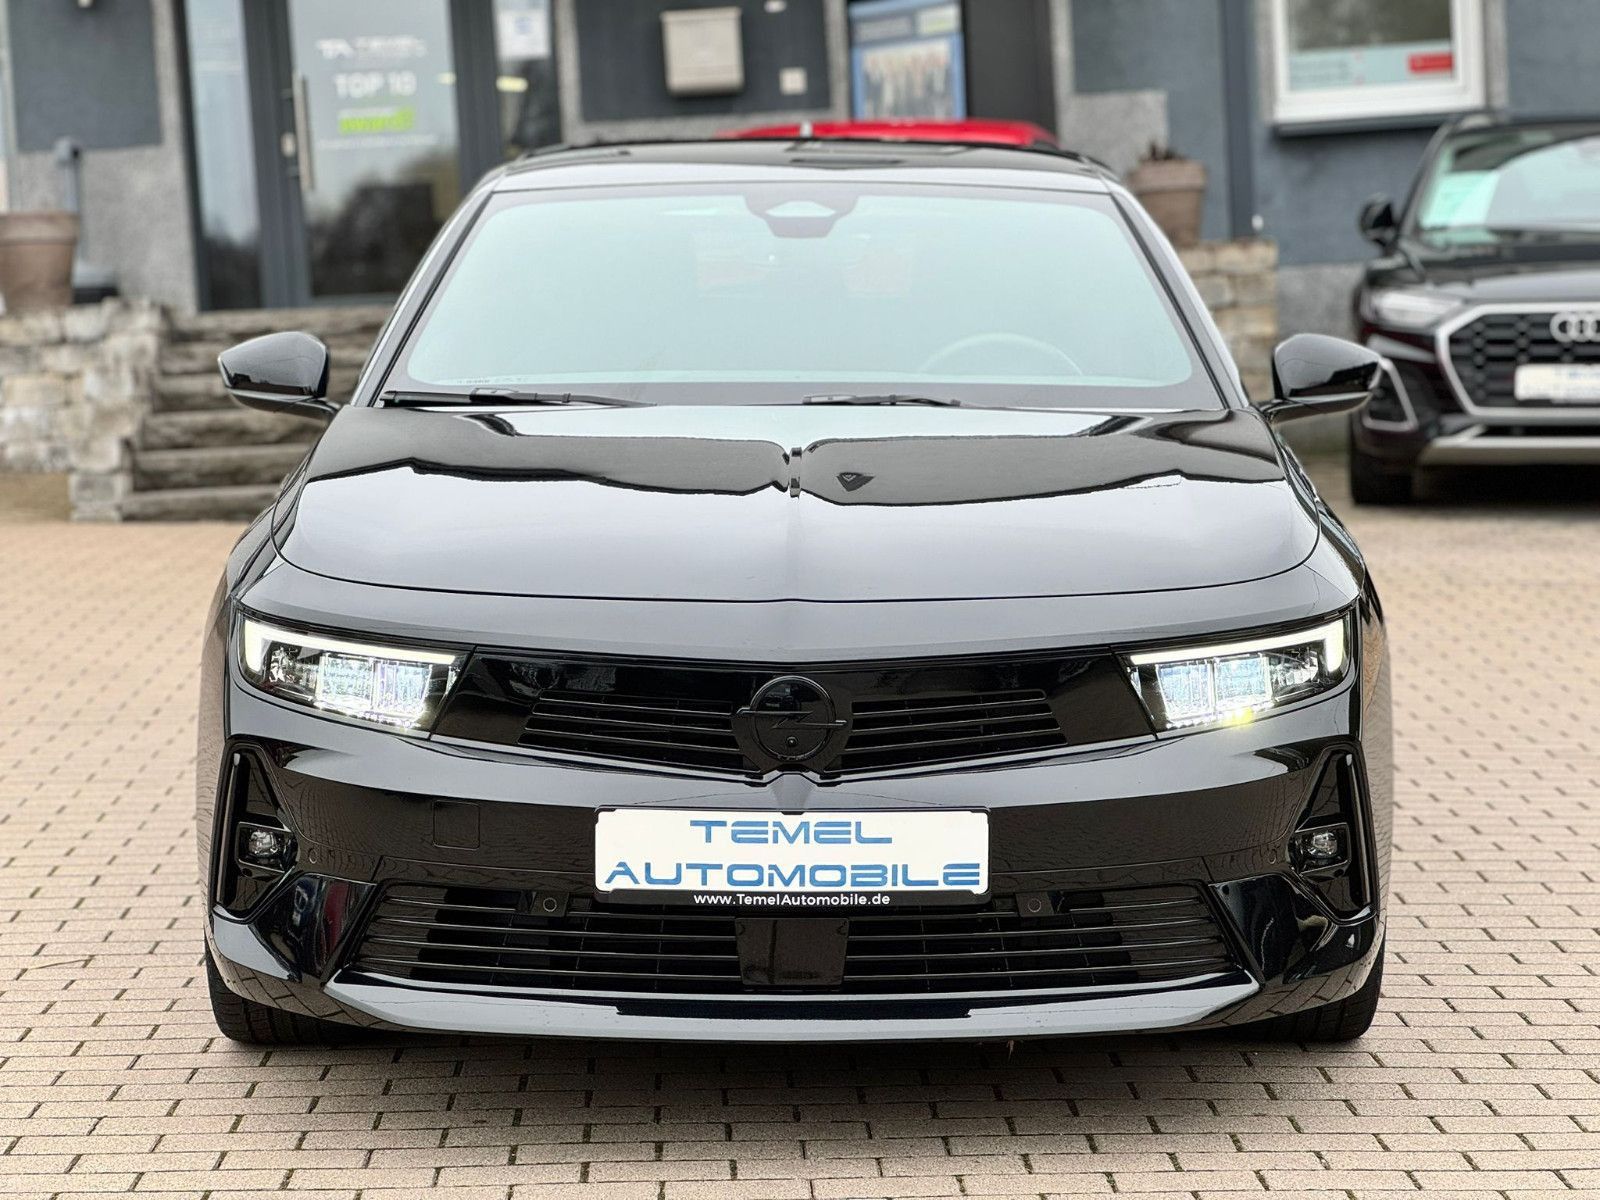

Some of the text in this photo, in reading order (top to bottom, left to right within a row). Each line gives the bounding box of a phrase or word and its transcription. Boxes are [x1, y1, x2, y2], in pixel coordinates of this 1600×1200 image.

[335, 70, 417, 99] TOP 10
[690, 820, 893, 844] TEMEL
[605, 861, 981, 888] AUTOMOBILE
[693, 892, 891, 906] www.TemelAutomobile.de
